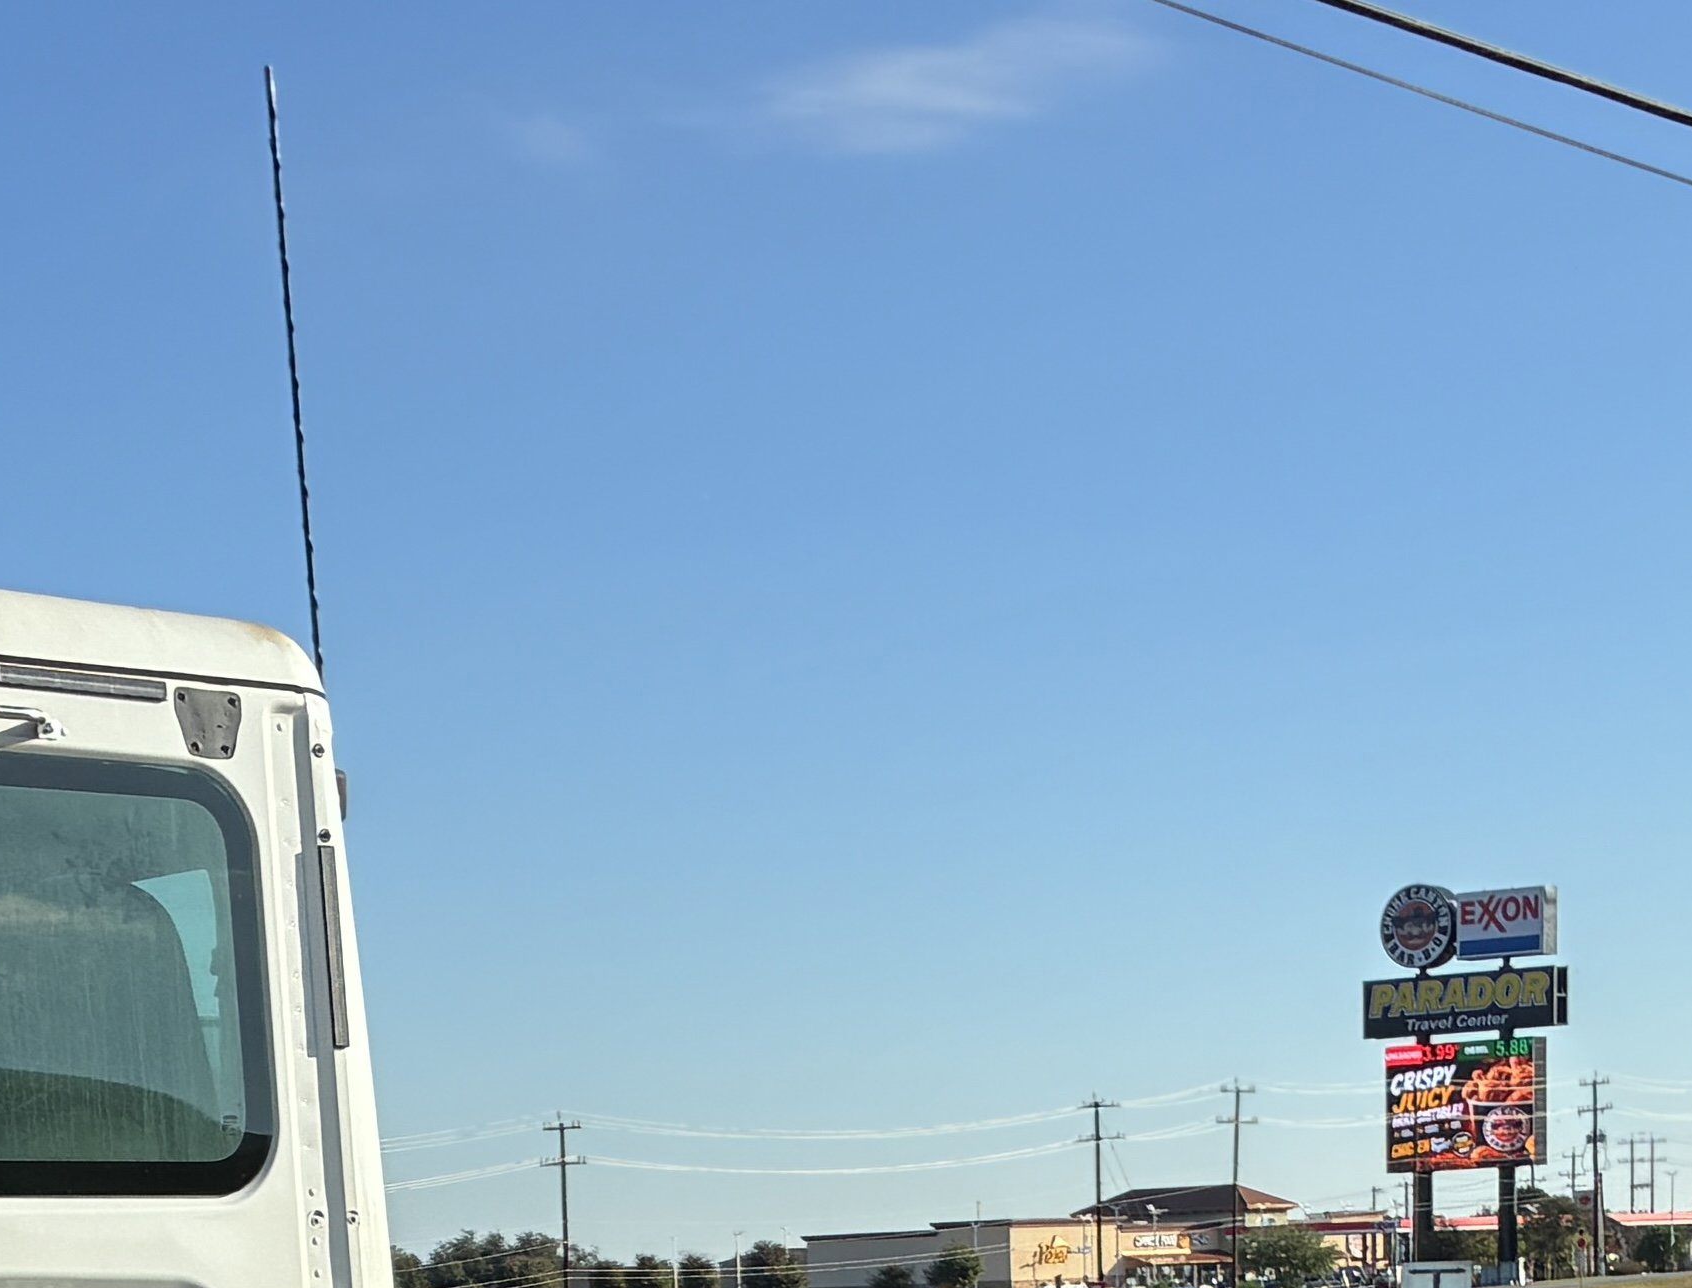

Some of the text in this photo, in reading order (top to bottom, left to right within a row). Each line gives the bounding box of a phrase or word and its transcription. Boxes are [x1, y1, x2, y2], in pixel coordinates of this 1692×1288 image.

[1460, 894, 1539, 933] EXXON
[1368, 971, 1551, 1019] PARADOR
[1407, 1012, 1508, 1033] Travel Center
[1390, 1064, 1457, 1097] CRISPY
[1392, 1085, 1455, 1114] JUICY
